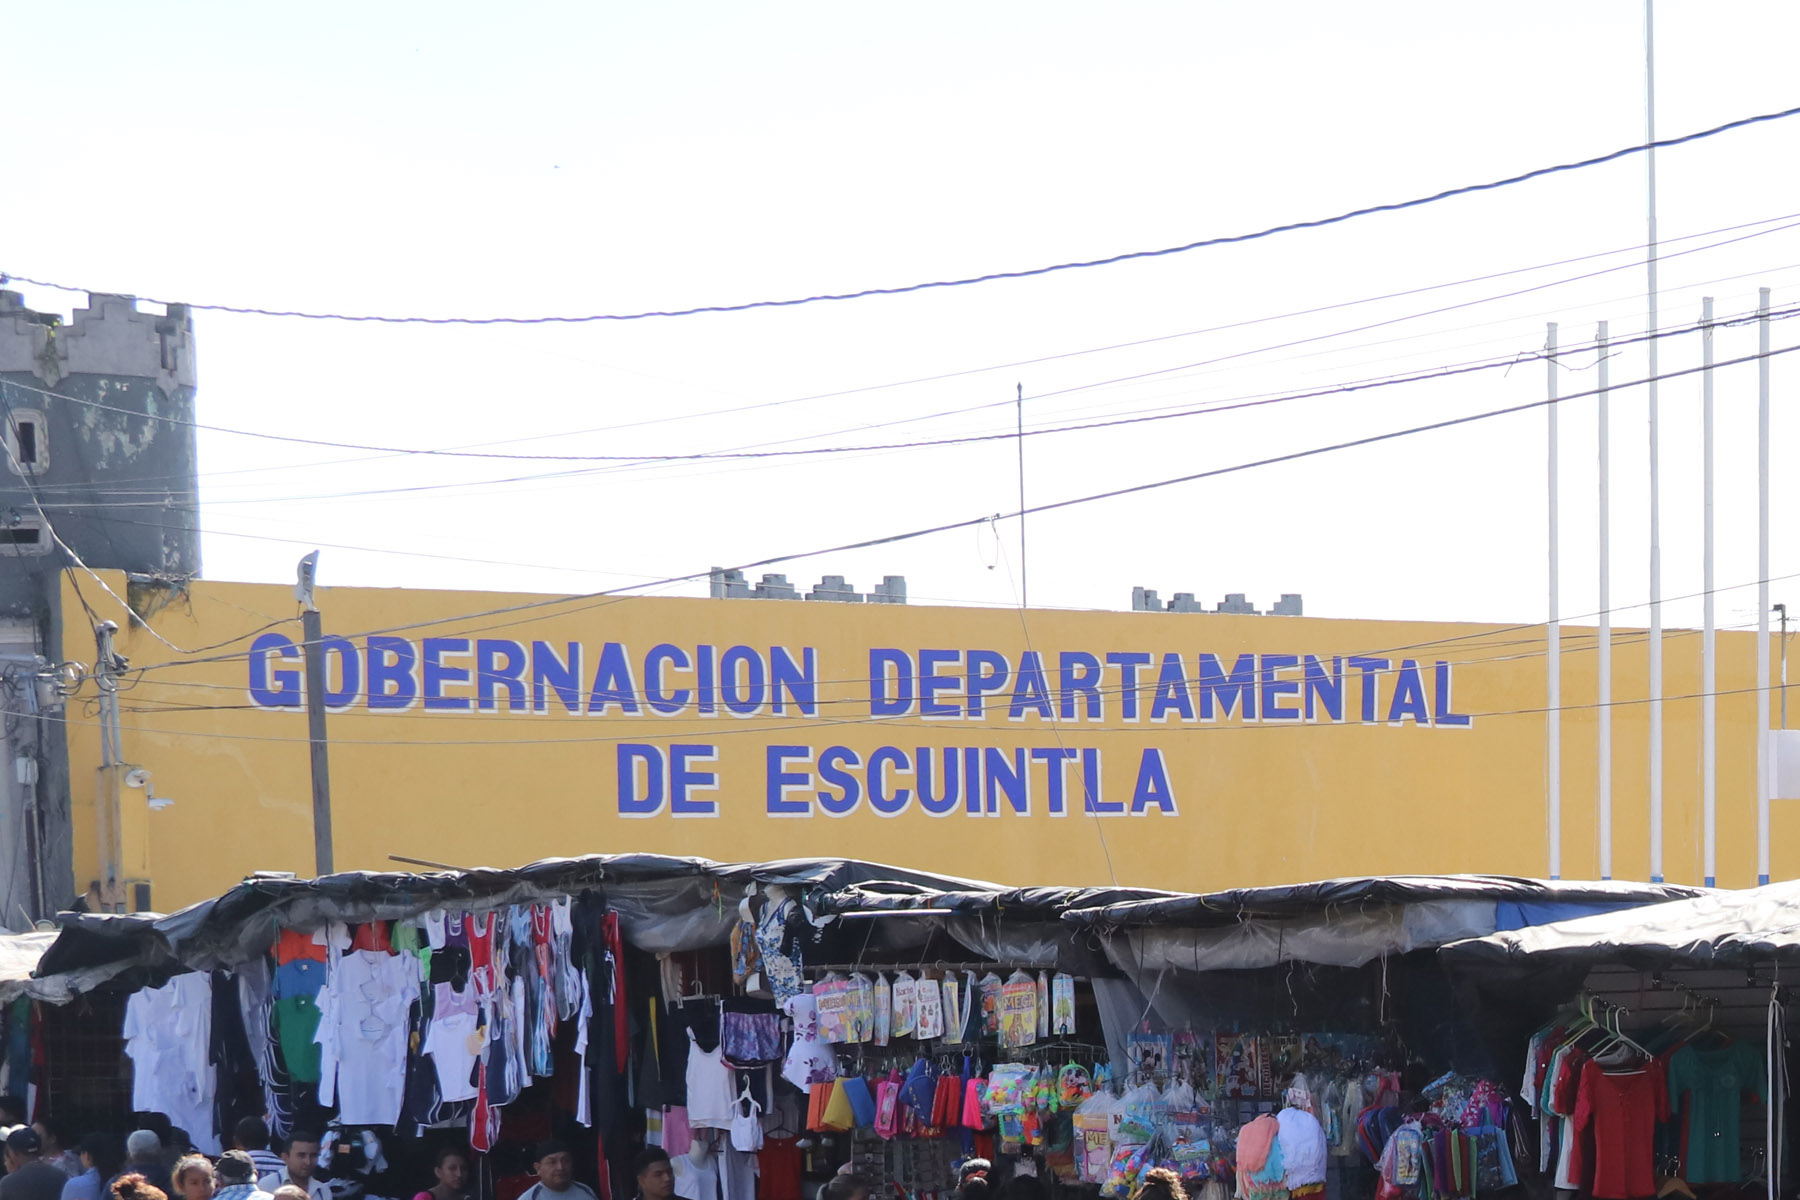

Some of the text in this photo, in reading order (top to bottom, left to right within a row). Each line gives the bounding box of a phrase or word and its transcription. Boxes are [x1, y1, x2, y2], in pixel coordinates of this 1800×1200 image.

[246, 632, 1473, 730] GOBERNACION DEPARTAMENTAL
[616, 743, 1180, 819] DE ESCUINTLA
[1003, 994, 1034, 1011] MEGA
